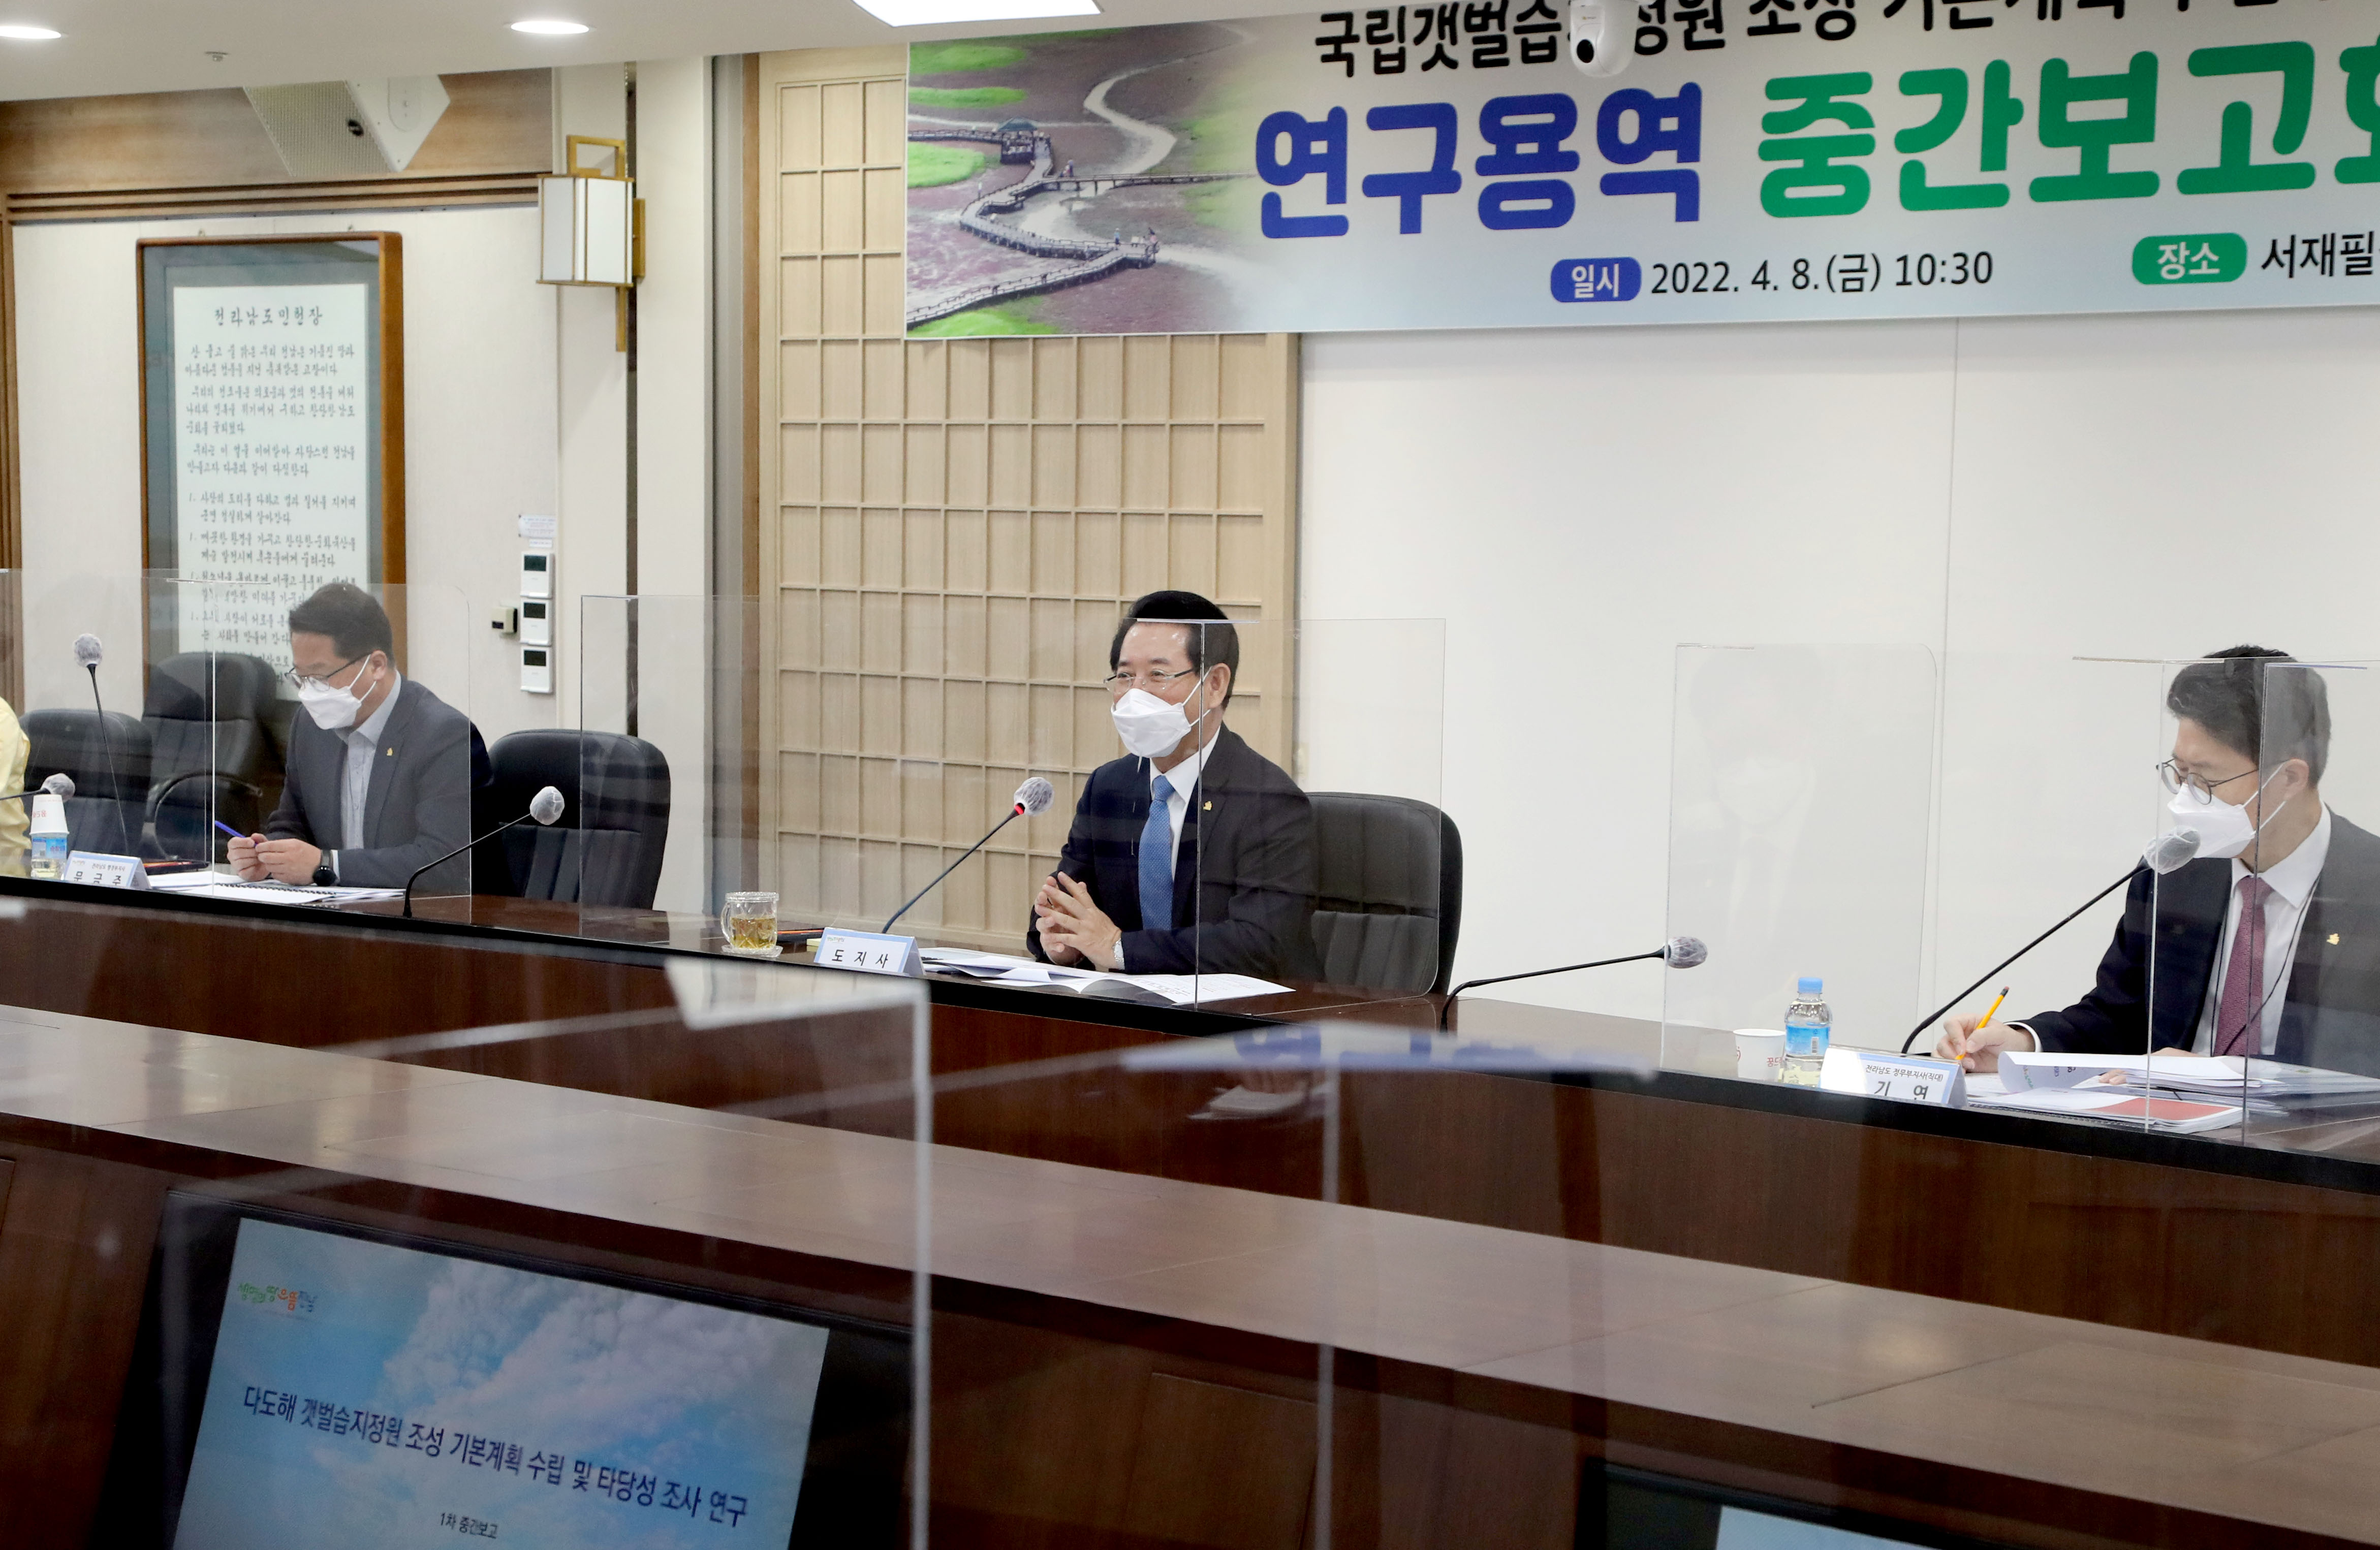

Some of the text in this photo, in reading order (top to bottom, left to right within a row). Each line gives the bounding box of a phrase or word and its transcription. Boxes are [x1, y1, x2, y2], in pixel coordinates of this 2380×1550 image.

[1314, 0, 1726, 77] 국립갯벌습정원
[1256, 81, 1702, 238] 연구용역
[1572, 251, 1993, 298] 일시 2022. 4. 8.(금) 10:30
[2157, 231, 2380, 279] 장소 서재필
[260, 344, 275, 356] 우리
[1866, 1065, 1891, 1074] 전라남도
[244, 1386, 748, 1527] 다도해 갯벌습지정원 조성 기본계획 수립 및 타당성 조사 연구
[440, 1512, 498, 1538] 1차 중간보고
